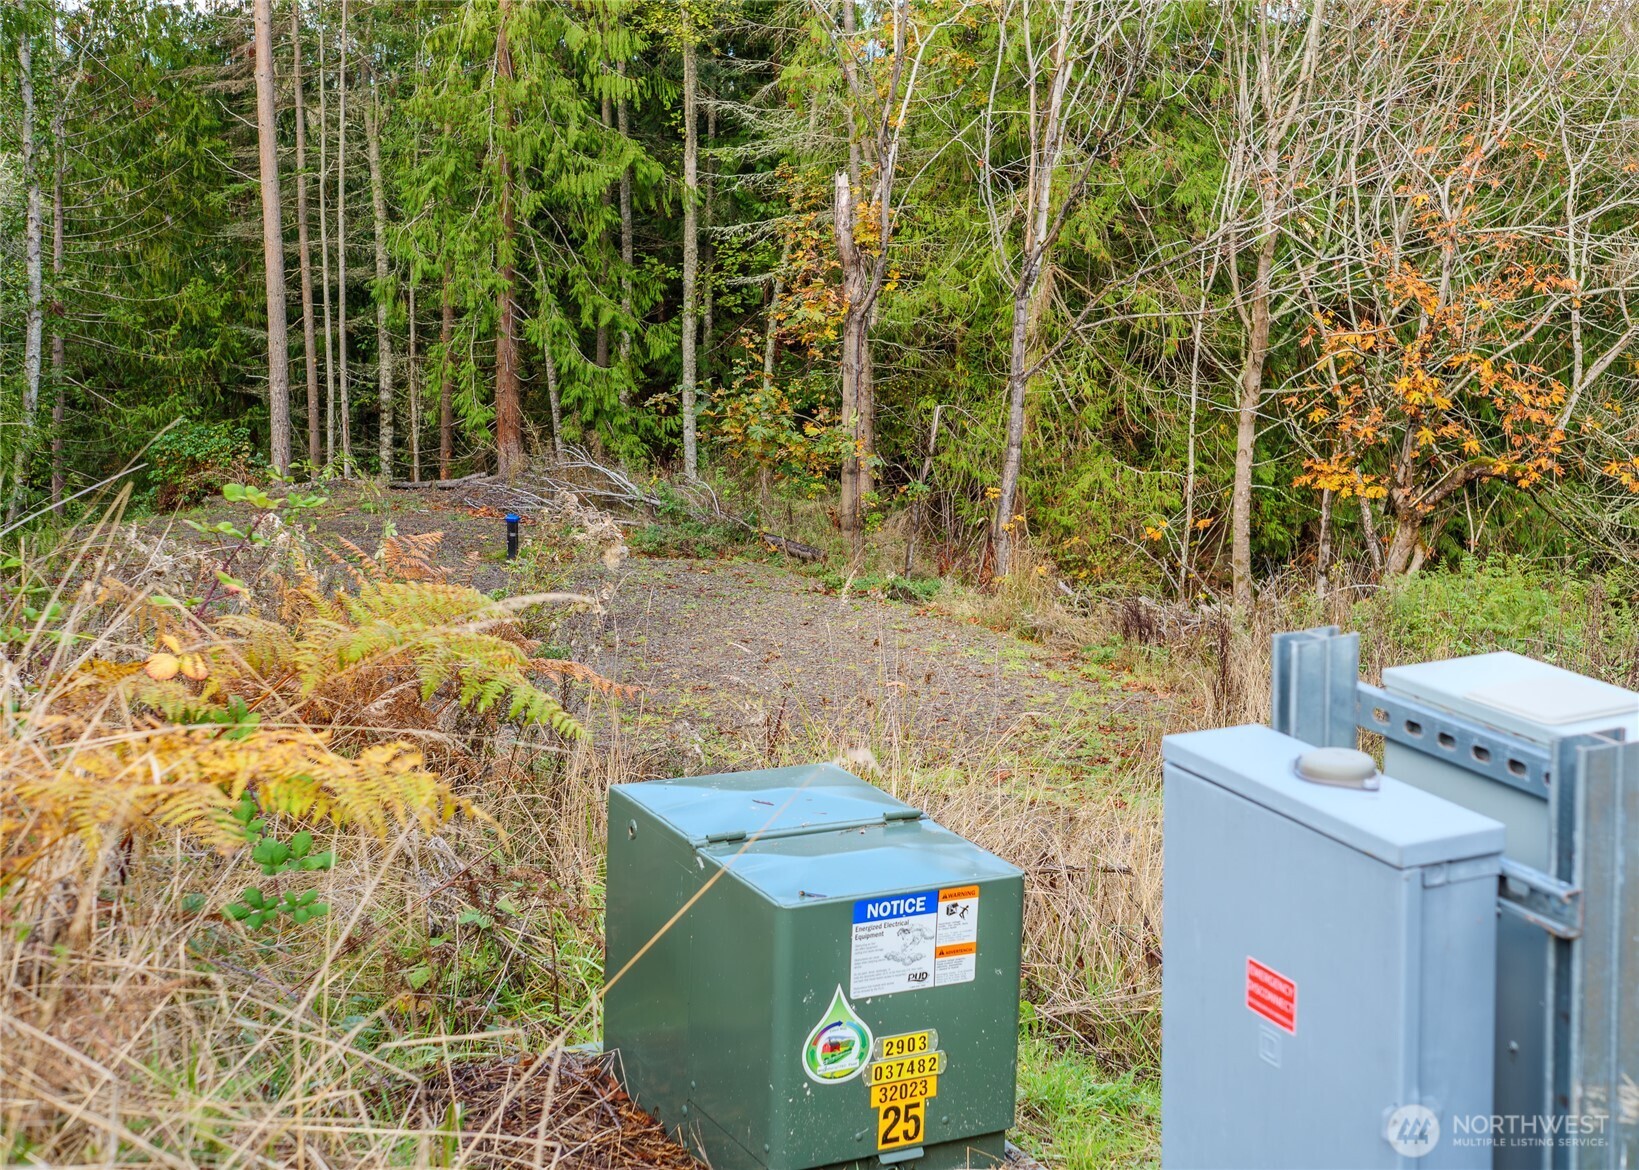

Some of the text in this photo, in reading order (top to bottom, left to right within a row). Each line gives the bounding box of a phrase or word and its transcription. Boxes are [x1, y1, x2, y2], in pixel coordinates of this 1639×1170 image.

[949, 890, 976, 898] WARNING
[866, 896, 926, 919] NOTICE
[854, 931, 884, 941] Equipment
[855, 920, 910, 933] Energized Electrical
[885, 1035, 927, 1057] 2903
[874, 1056, 937, 1081] 037482
[879, 1080, 928, 1104] 32023
[881, 1101, 921, 1146] 25
